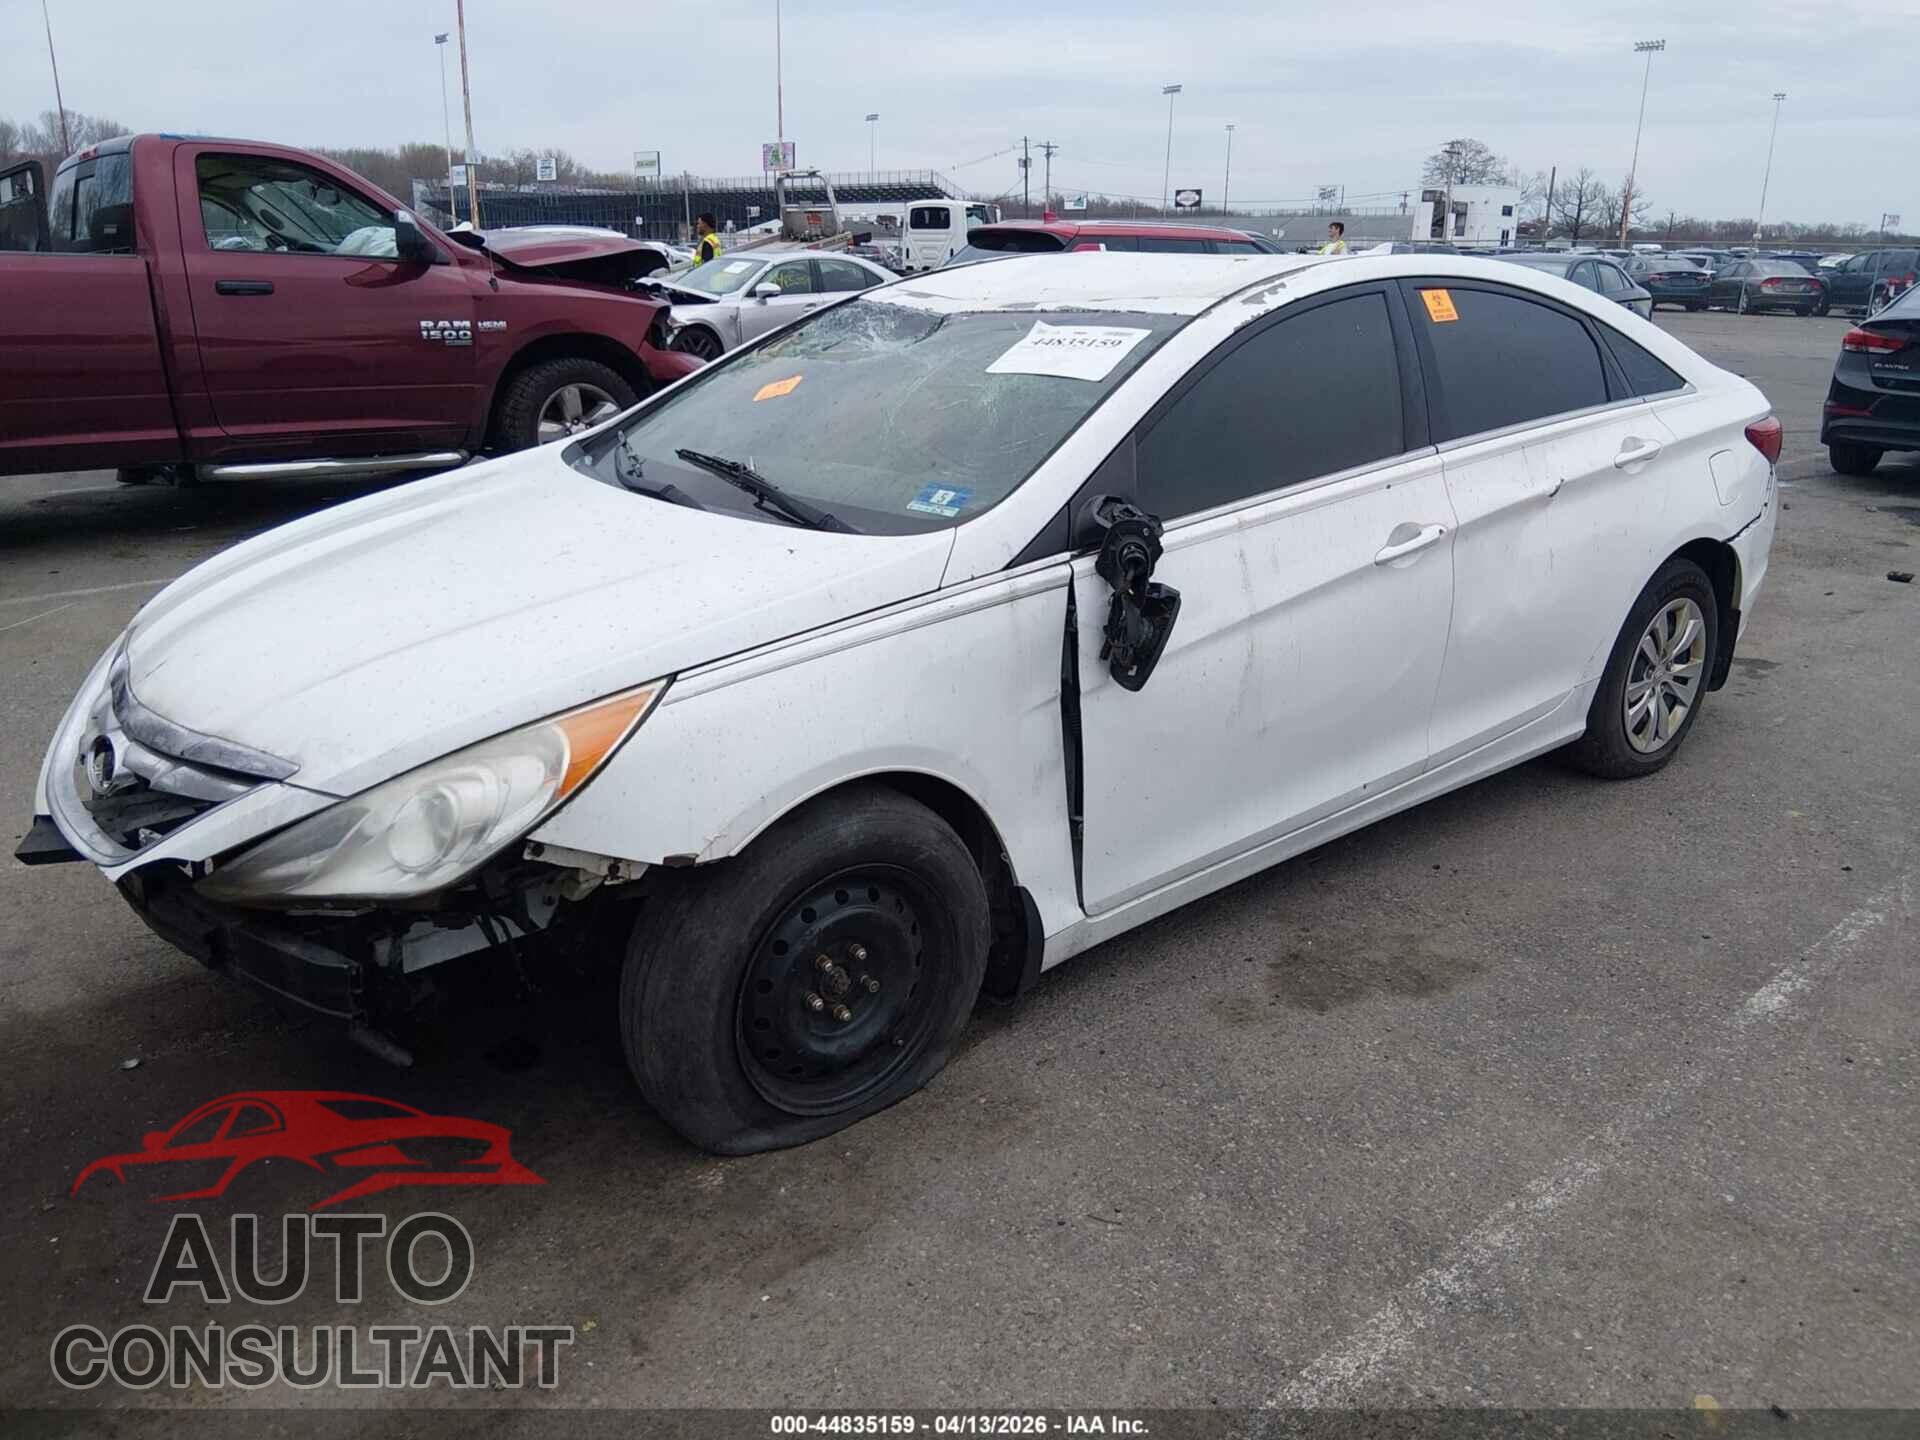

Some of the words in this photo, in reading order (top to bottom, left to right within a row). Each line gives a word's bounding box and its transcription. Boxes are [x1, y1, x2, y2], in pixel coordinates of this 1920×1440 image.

[420, 320, 471, 329] RAM
[478, 320, 507, 329] HEMI
[421, 330, 472, 340] 1500
